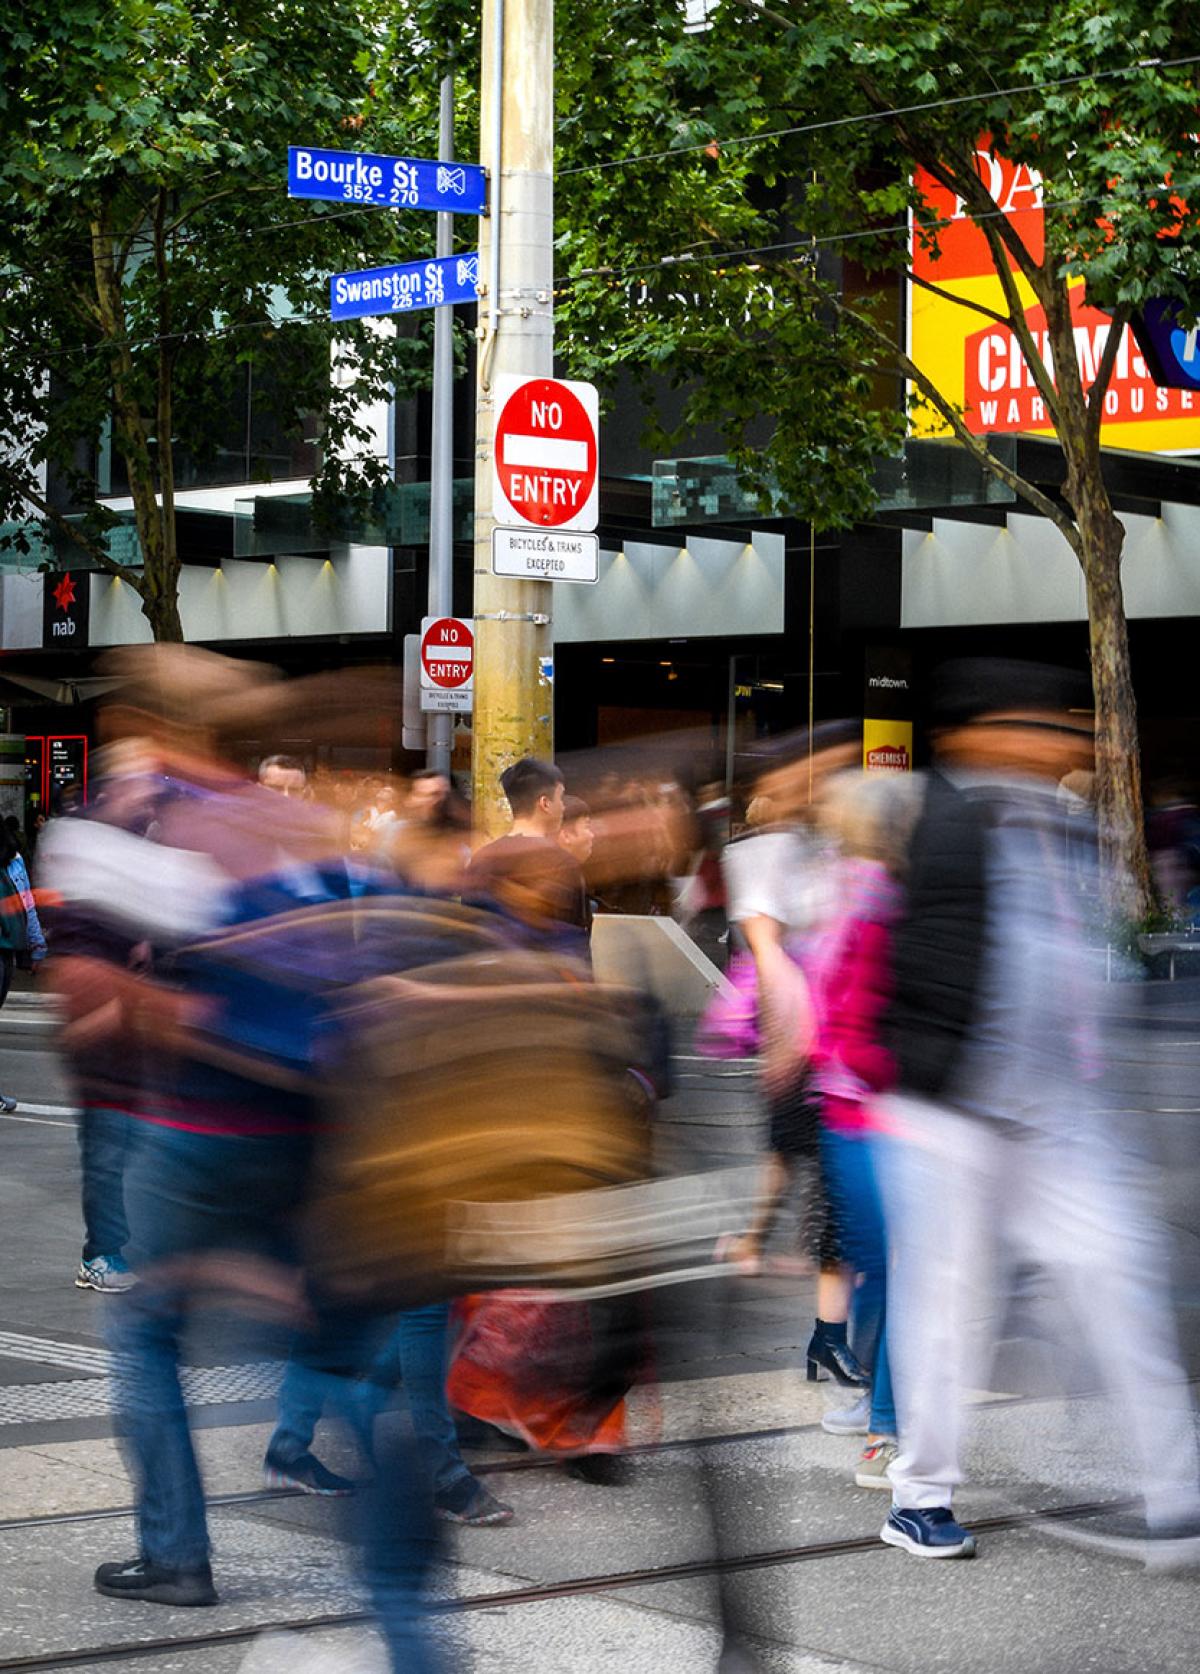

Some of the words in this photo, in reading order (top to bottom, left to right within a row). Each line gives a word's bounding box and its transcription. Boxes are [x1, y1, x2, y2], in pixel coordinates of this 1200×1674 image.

[296, 151, 383, 187] Bourke
[393, 160, 419, 191] St
[343, 184, 373, 201] 352
[390, 188, 419, 205] 270
[336, 271, 421, 304] Swanston
[424, 263, 444, 289] St
[392, 293, 413, 309] 225
[425, 289, 445, 304] 179
[531, 400, 563, 430] NO
[979, 386, 1194, 425] WAROUSE
[510, 473, 582, 506] ENTRY
[509, 536, 547, 551] BICYCLES
[548, 541, 555, 553] &
[557, 541, 583, 554] TRAMS
[526, 557, 565, 571] EXCEPTED
[52, 617, 76, 637] nab
[440, 628, 459, 643] NO
[430, 663, 469, 678] ENTRY
[868, 752, 907, 765] CHEMIST
